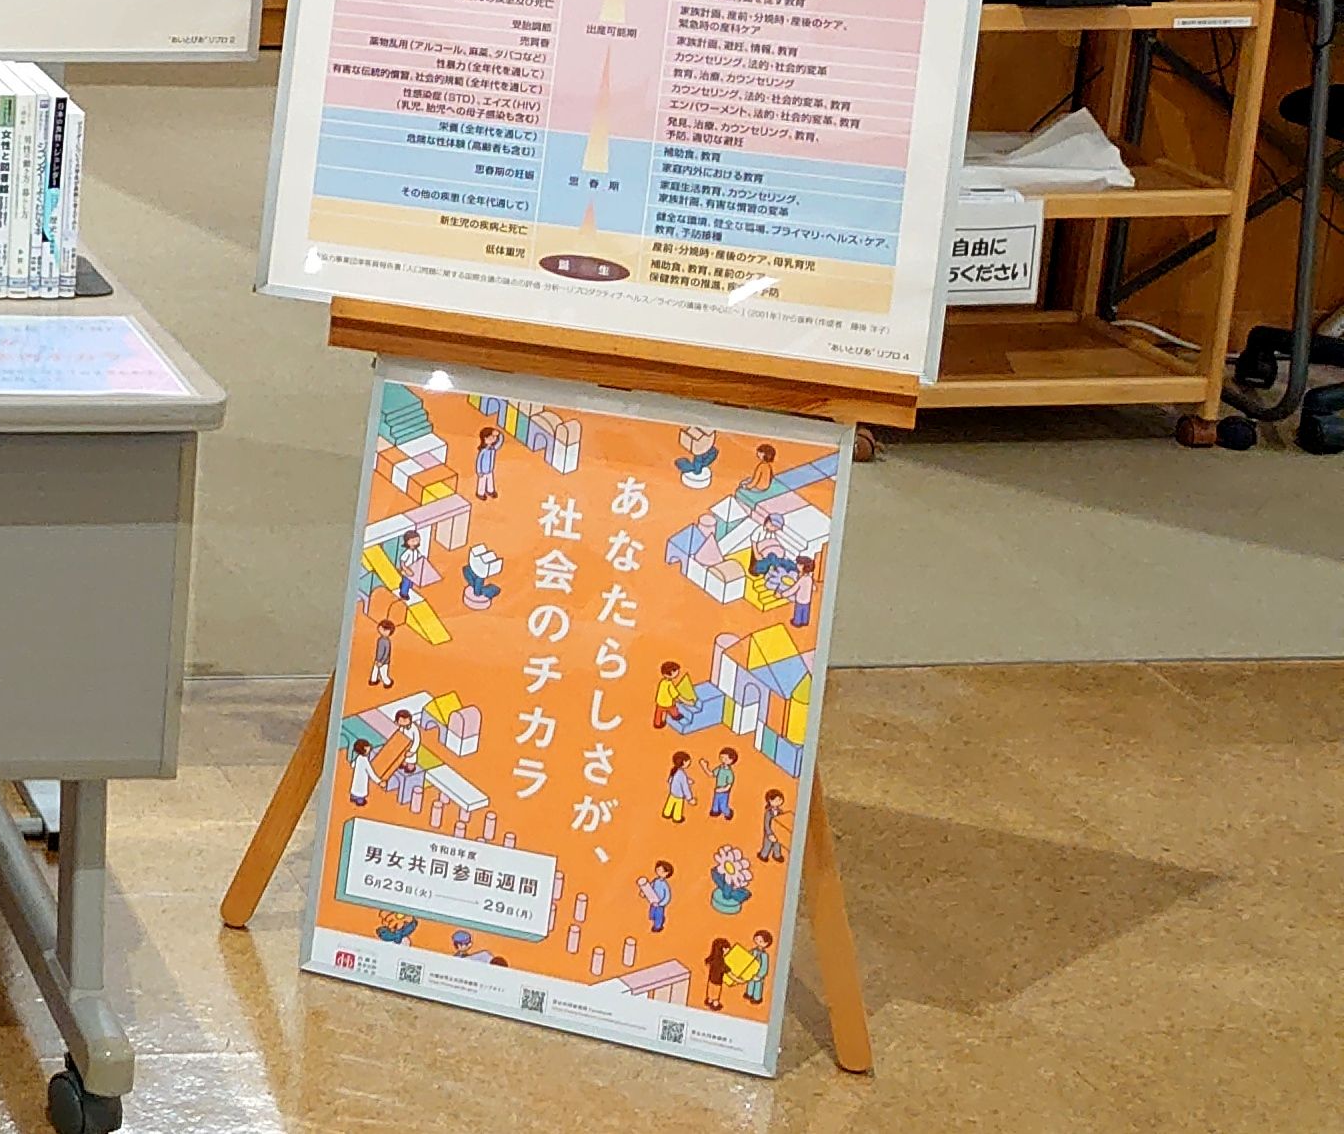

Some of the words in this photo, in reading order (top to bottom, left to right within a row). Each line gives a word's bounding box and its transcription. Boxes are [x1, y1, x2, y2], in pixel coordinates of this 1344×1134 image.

[952, 236, 1007, 257] 自由に
[511, 493, 583, 801] 社会のチカラ
[429, 843, 477, 861] 令和8年度
[364, 845, 538, 898] 男女共同参画週間
